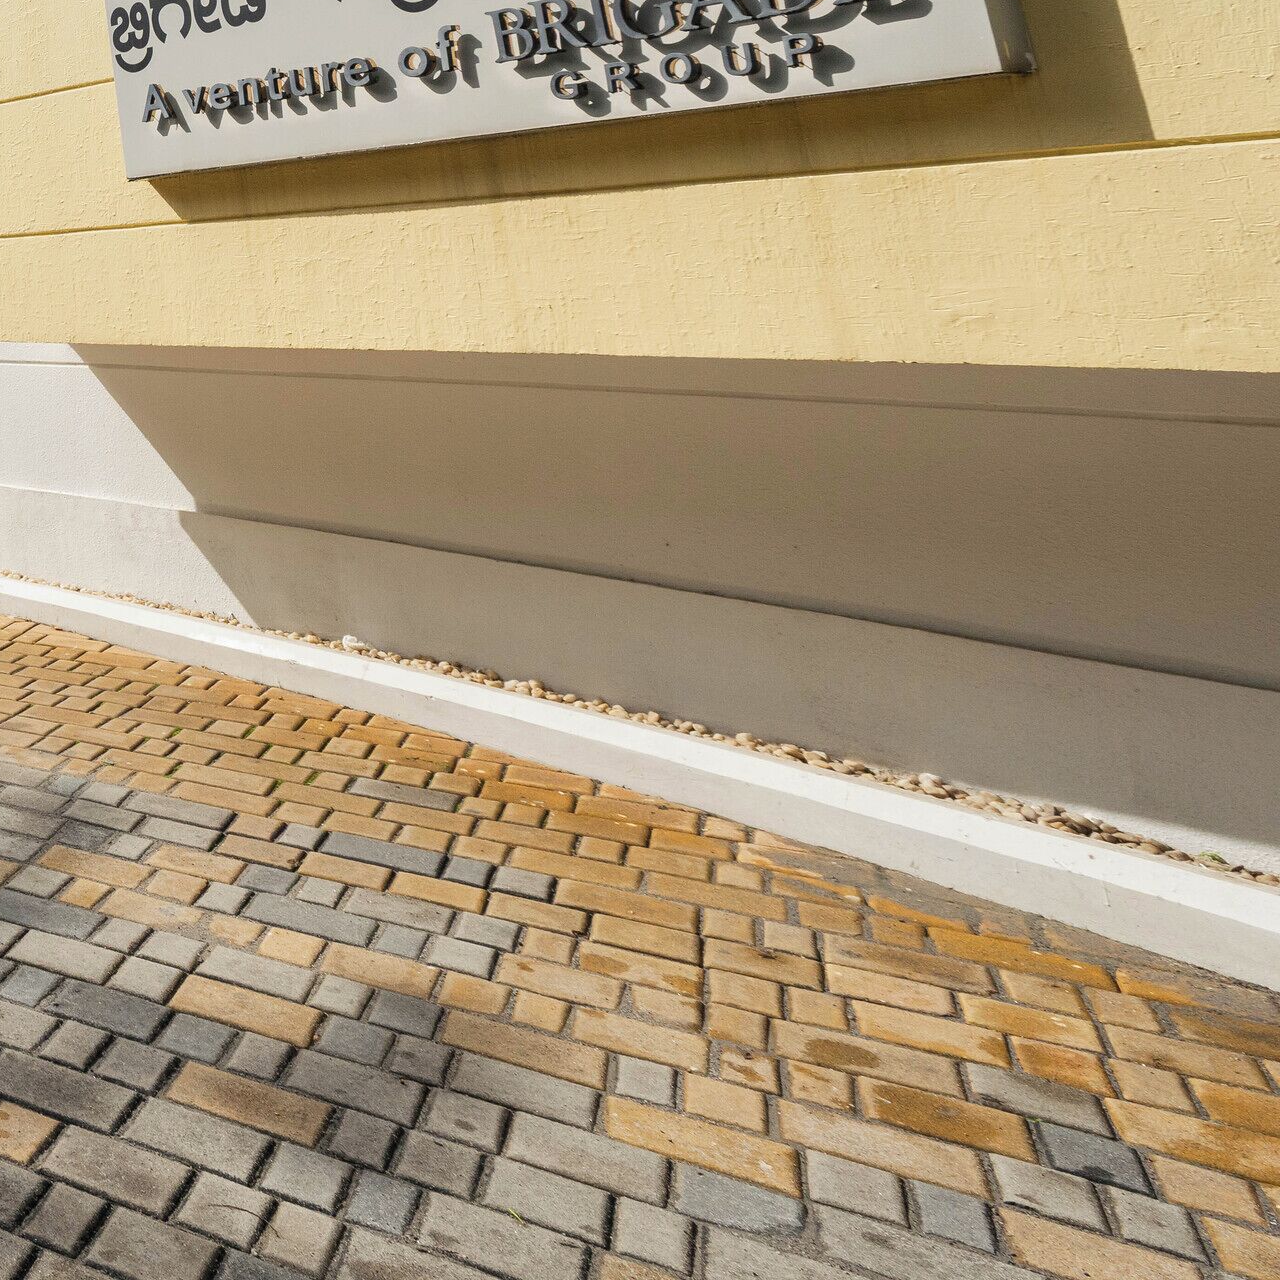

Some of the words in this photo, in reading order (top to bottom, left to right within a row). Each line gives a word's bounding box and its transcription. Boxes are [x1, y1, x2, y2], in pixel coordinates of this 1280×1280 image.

[142, 83, 172, 123] A
[182, 56, 377, 114] venture
[398, 24, 460, 77] of
[550, 33, 822, 100] GROUP
